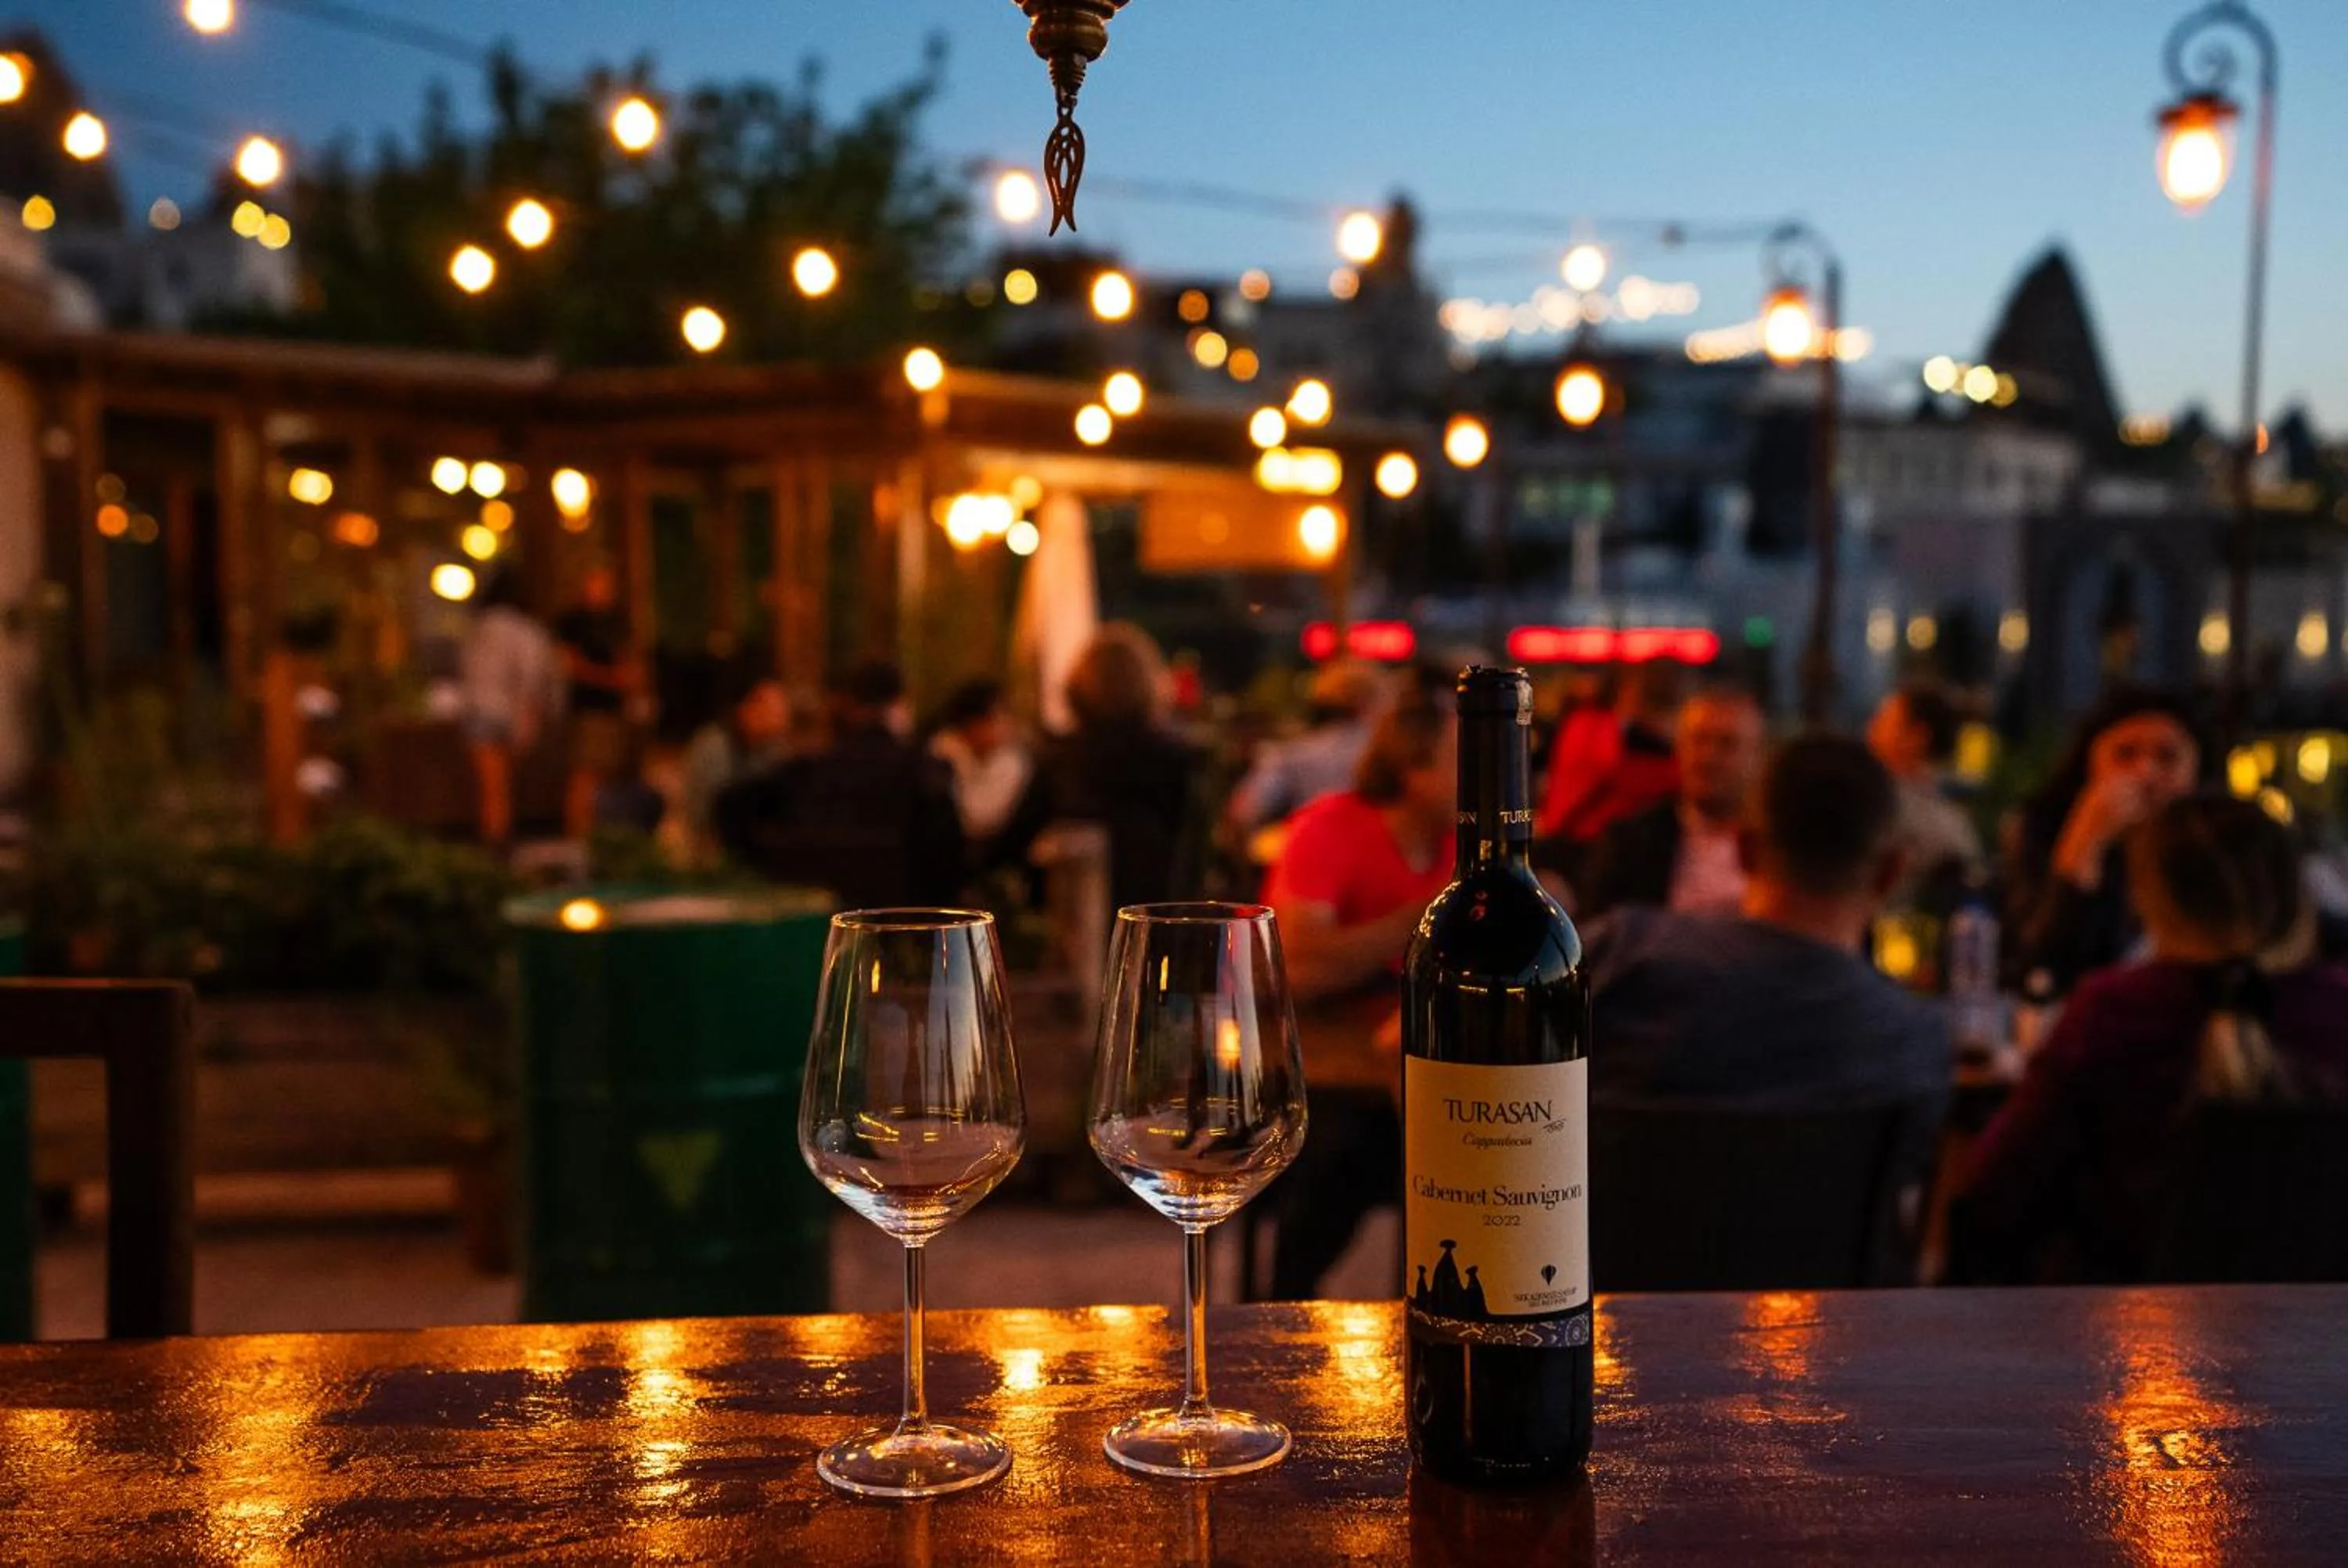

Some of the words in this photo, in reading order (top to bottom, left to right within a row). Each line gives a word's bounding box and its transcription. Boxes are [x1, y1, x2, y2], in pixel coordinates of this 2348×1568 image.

[1442, 1099, 1553, 1124] TURASAN
[1413, 1175, 1486, 1206] Cabernet
[1492, 1184, 1583, 1210] Sauvignon
[1482, 1215, 1521, 1227] 2022
